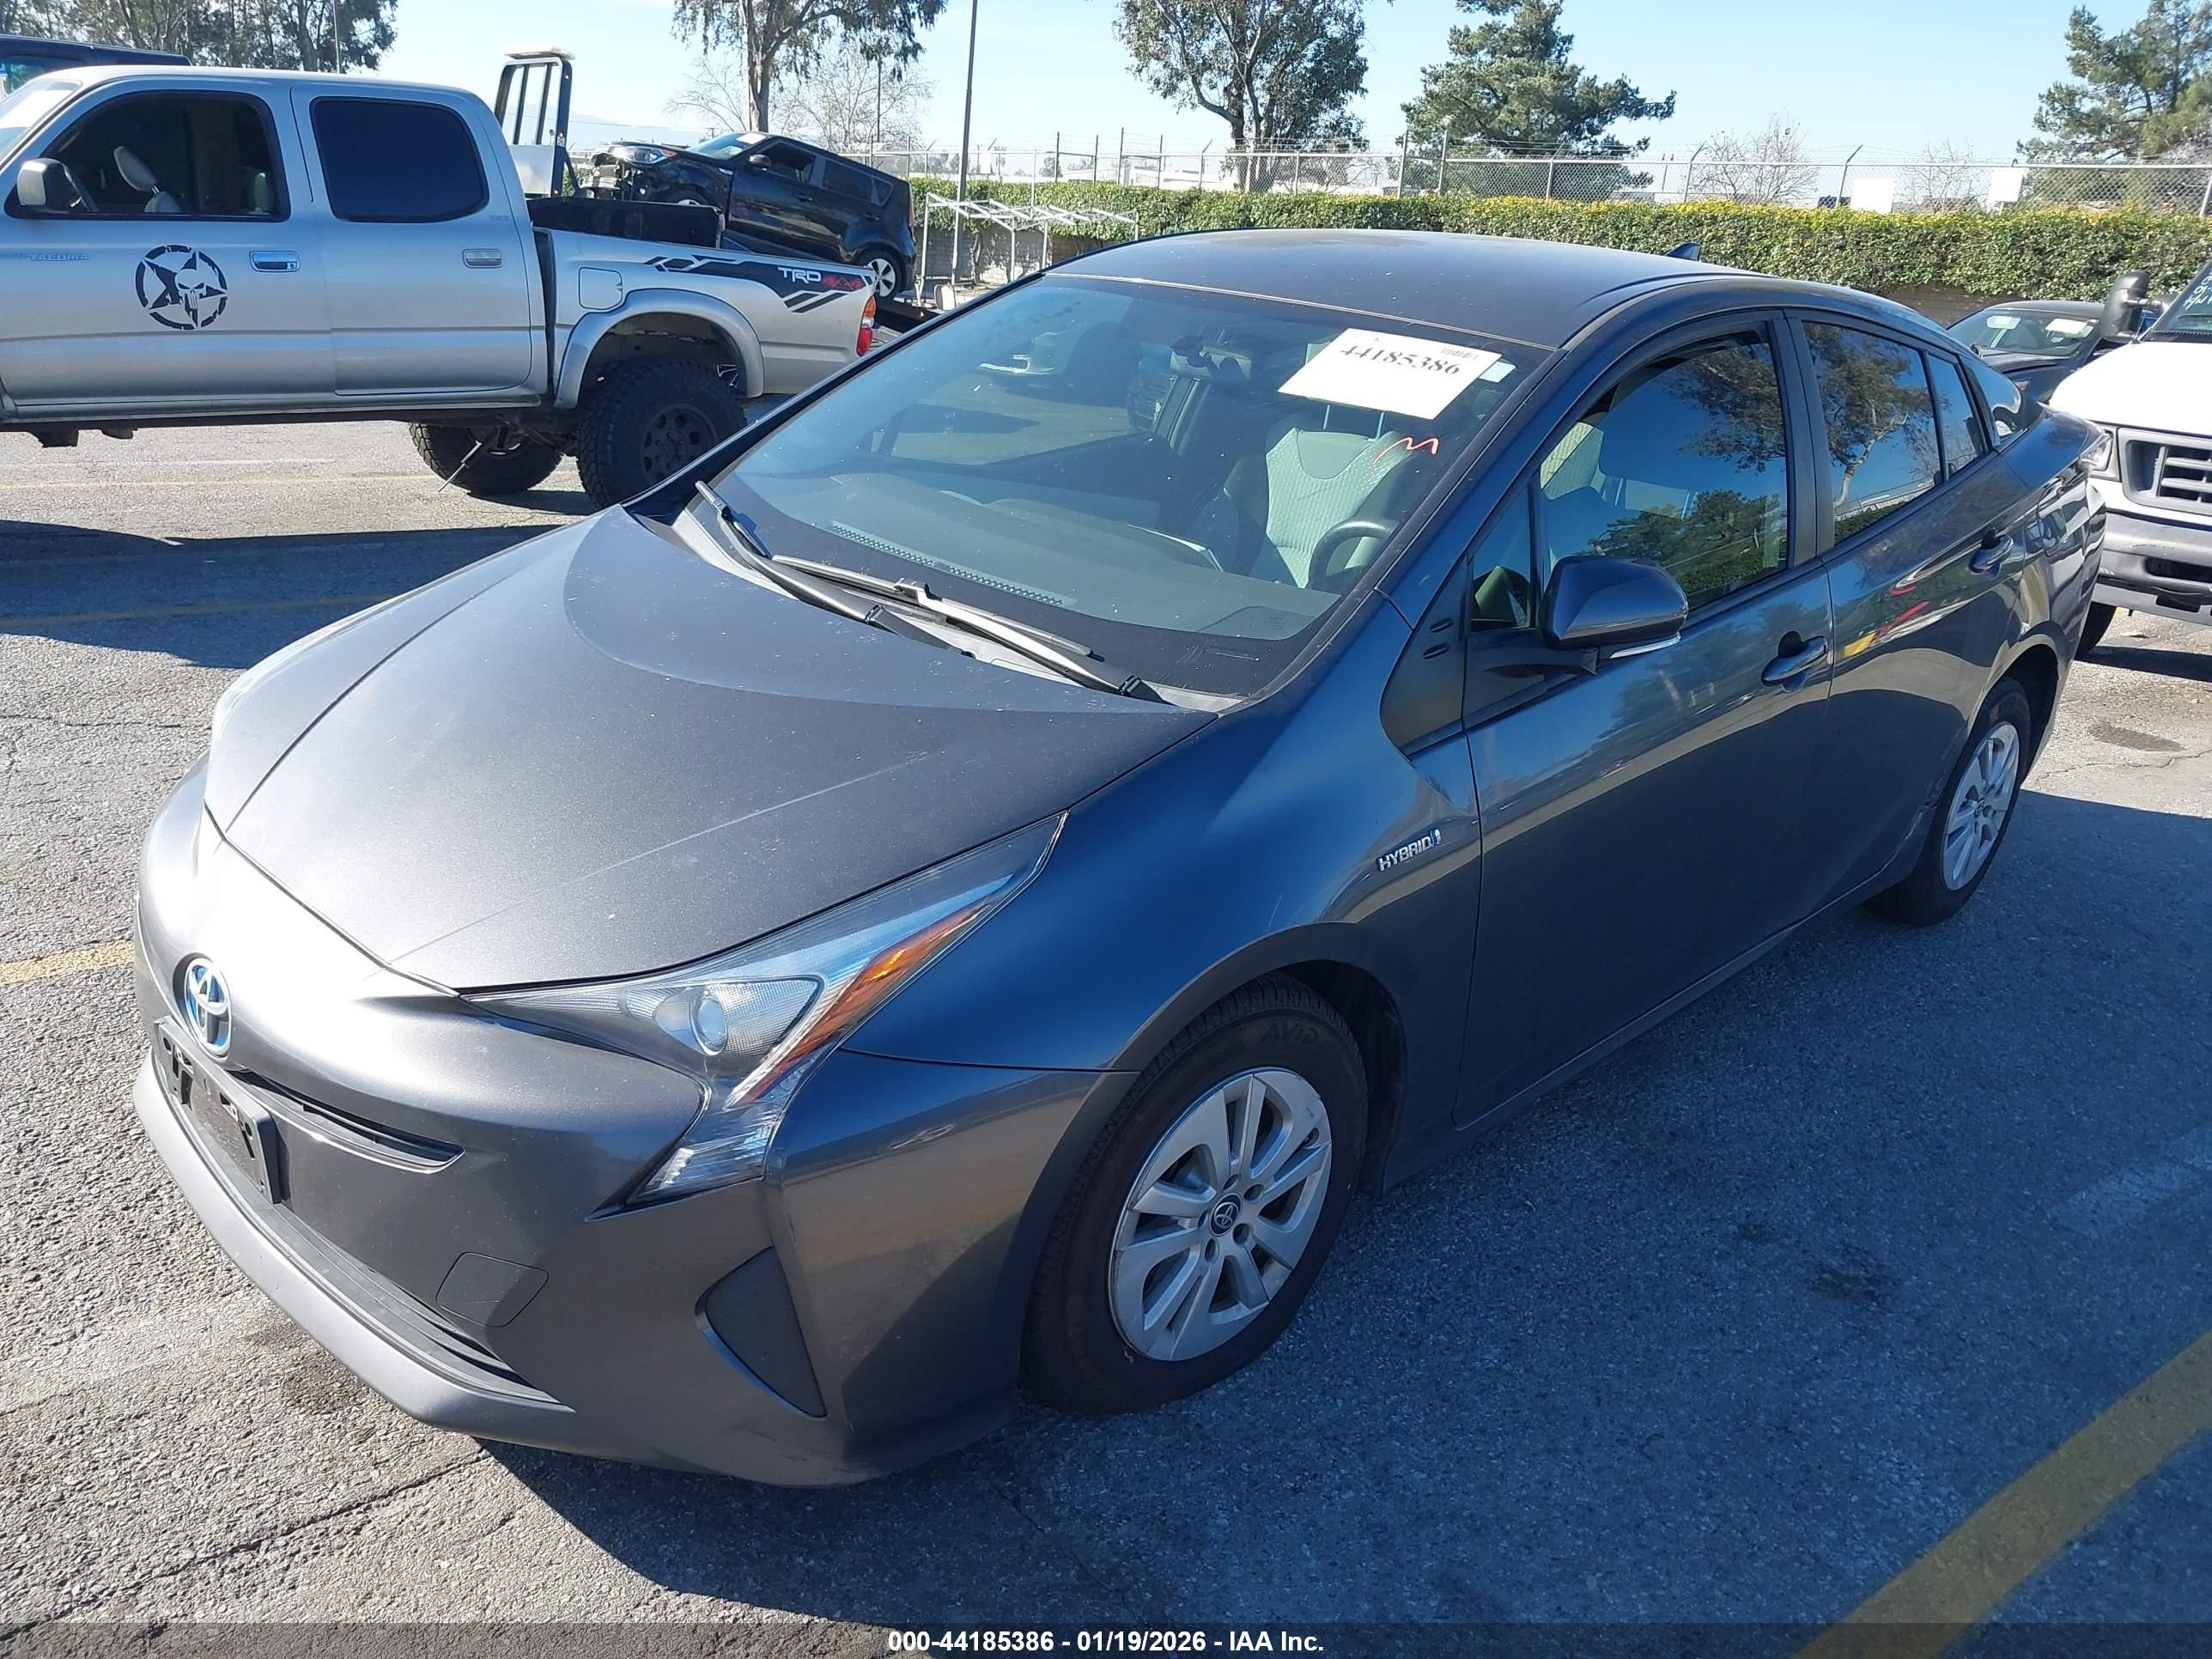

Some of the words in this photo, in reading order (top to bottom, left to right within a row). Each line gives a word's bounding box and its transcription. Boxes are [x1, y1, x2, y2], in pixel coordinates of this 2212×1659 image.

[777, 266, 822, 284] TRD
[1340, 345, 1462, 375] 44185386
[1378, 836, 1432, 872] HYBRID
